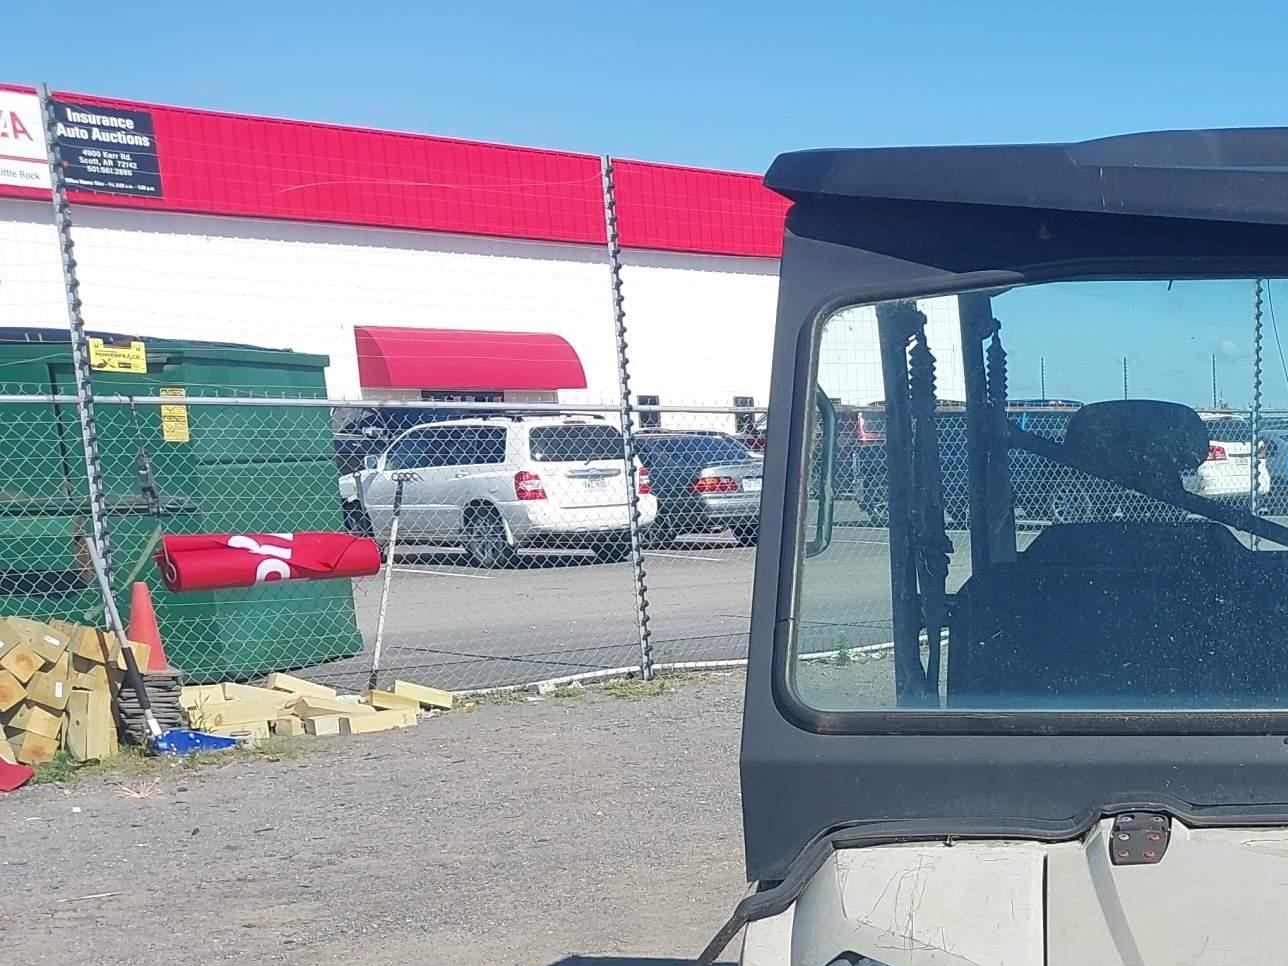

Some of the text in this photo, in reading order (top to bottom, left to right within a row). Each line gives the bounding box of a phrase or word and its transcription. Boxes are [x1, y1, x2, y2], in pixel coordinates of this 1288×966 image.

[66, 108, 134, 129] Insurance
[56, 122, 150, 147] Auto Auctions
[78, 156, 101, 166] Scott,
[102, 151, 118, 159] Kerr
[0, 168, 41, 180] ittle Rock
